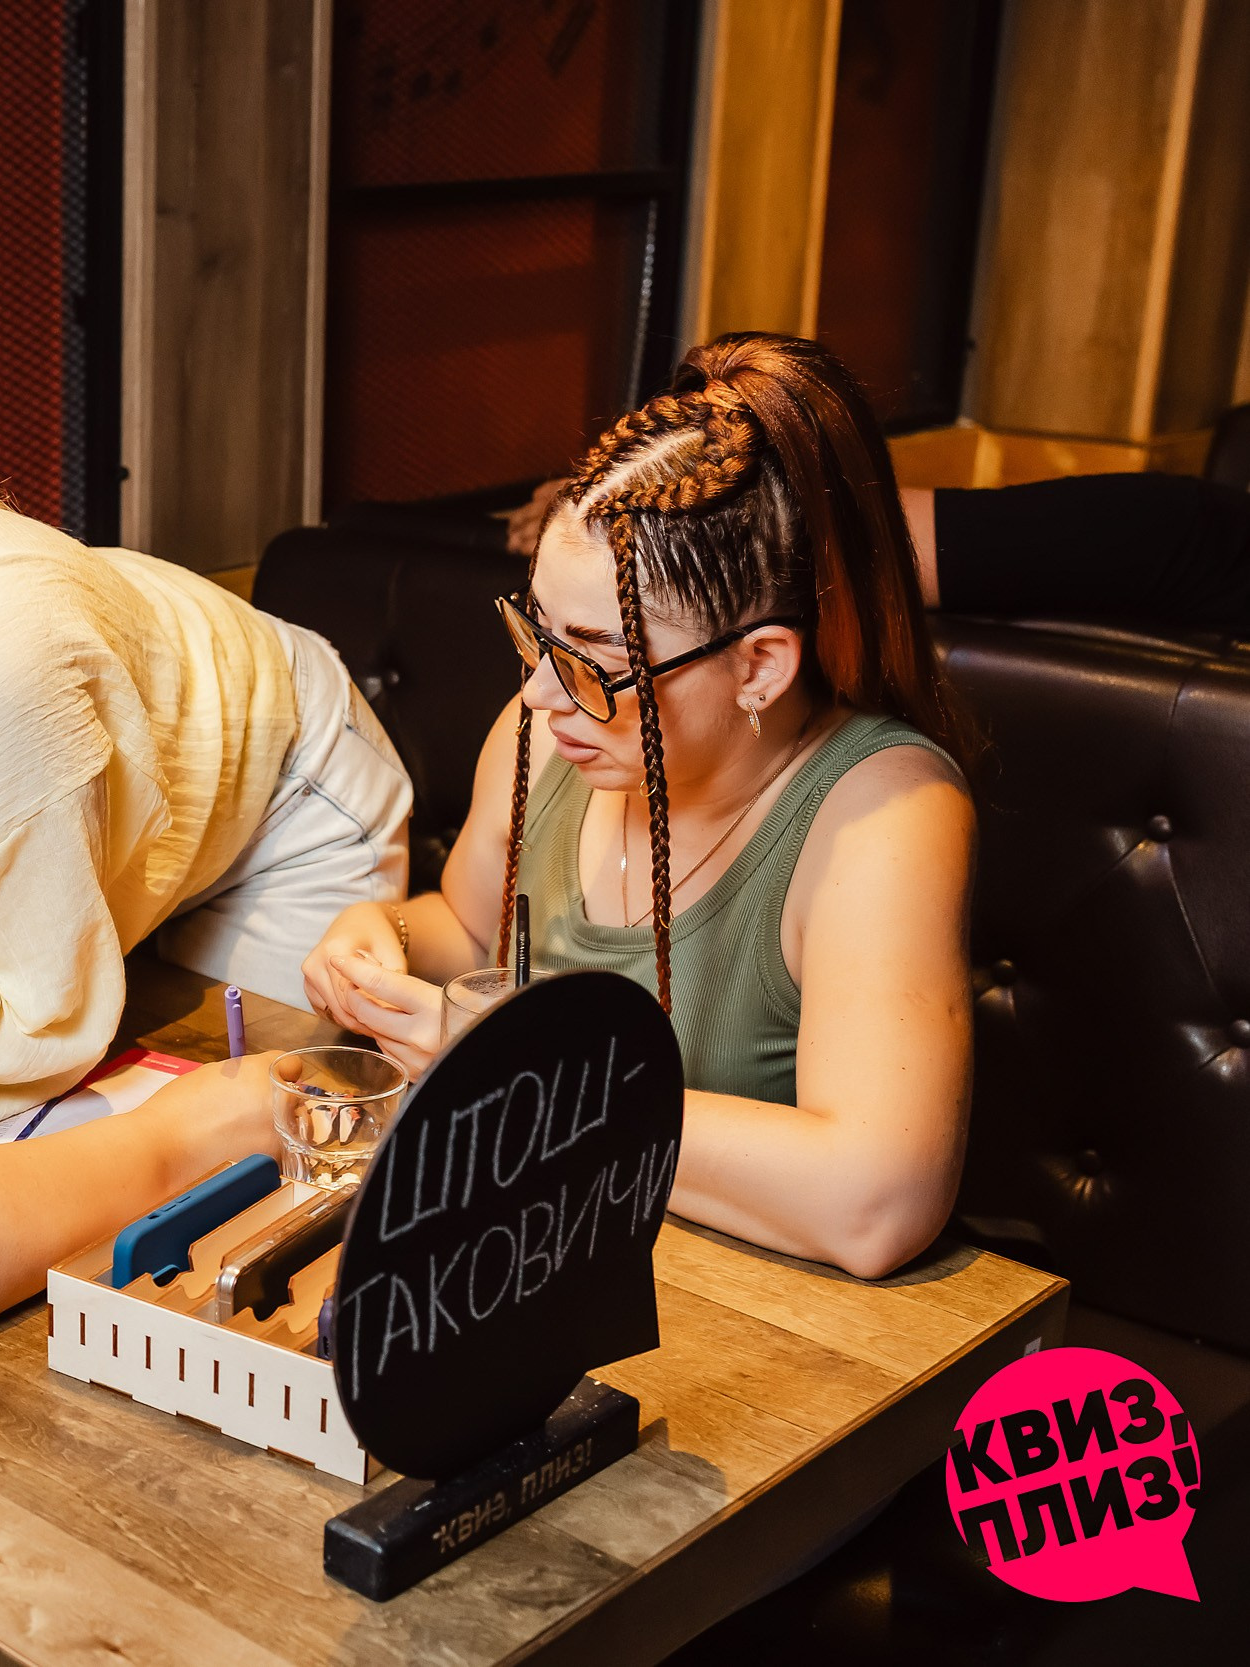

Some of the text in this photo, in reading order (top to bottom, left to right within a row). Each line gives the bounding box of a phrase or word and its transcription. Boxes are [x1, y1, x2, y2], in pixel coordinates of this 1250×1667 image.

[379, 1036, 646, 1243] ШТОШ-
[341, 1139, 676, 1401] ТАКОВИЧИ
[520, 1438, 593, 1505] ПЛИЗ!
